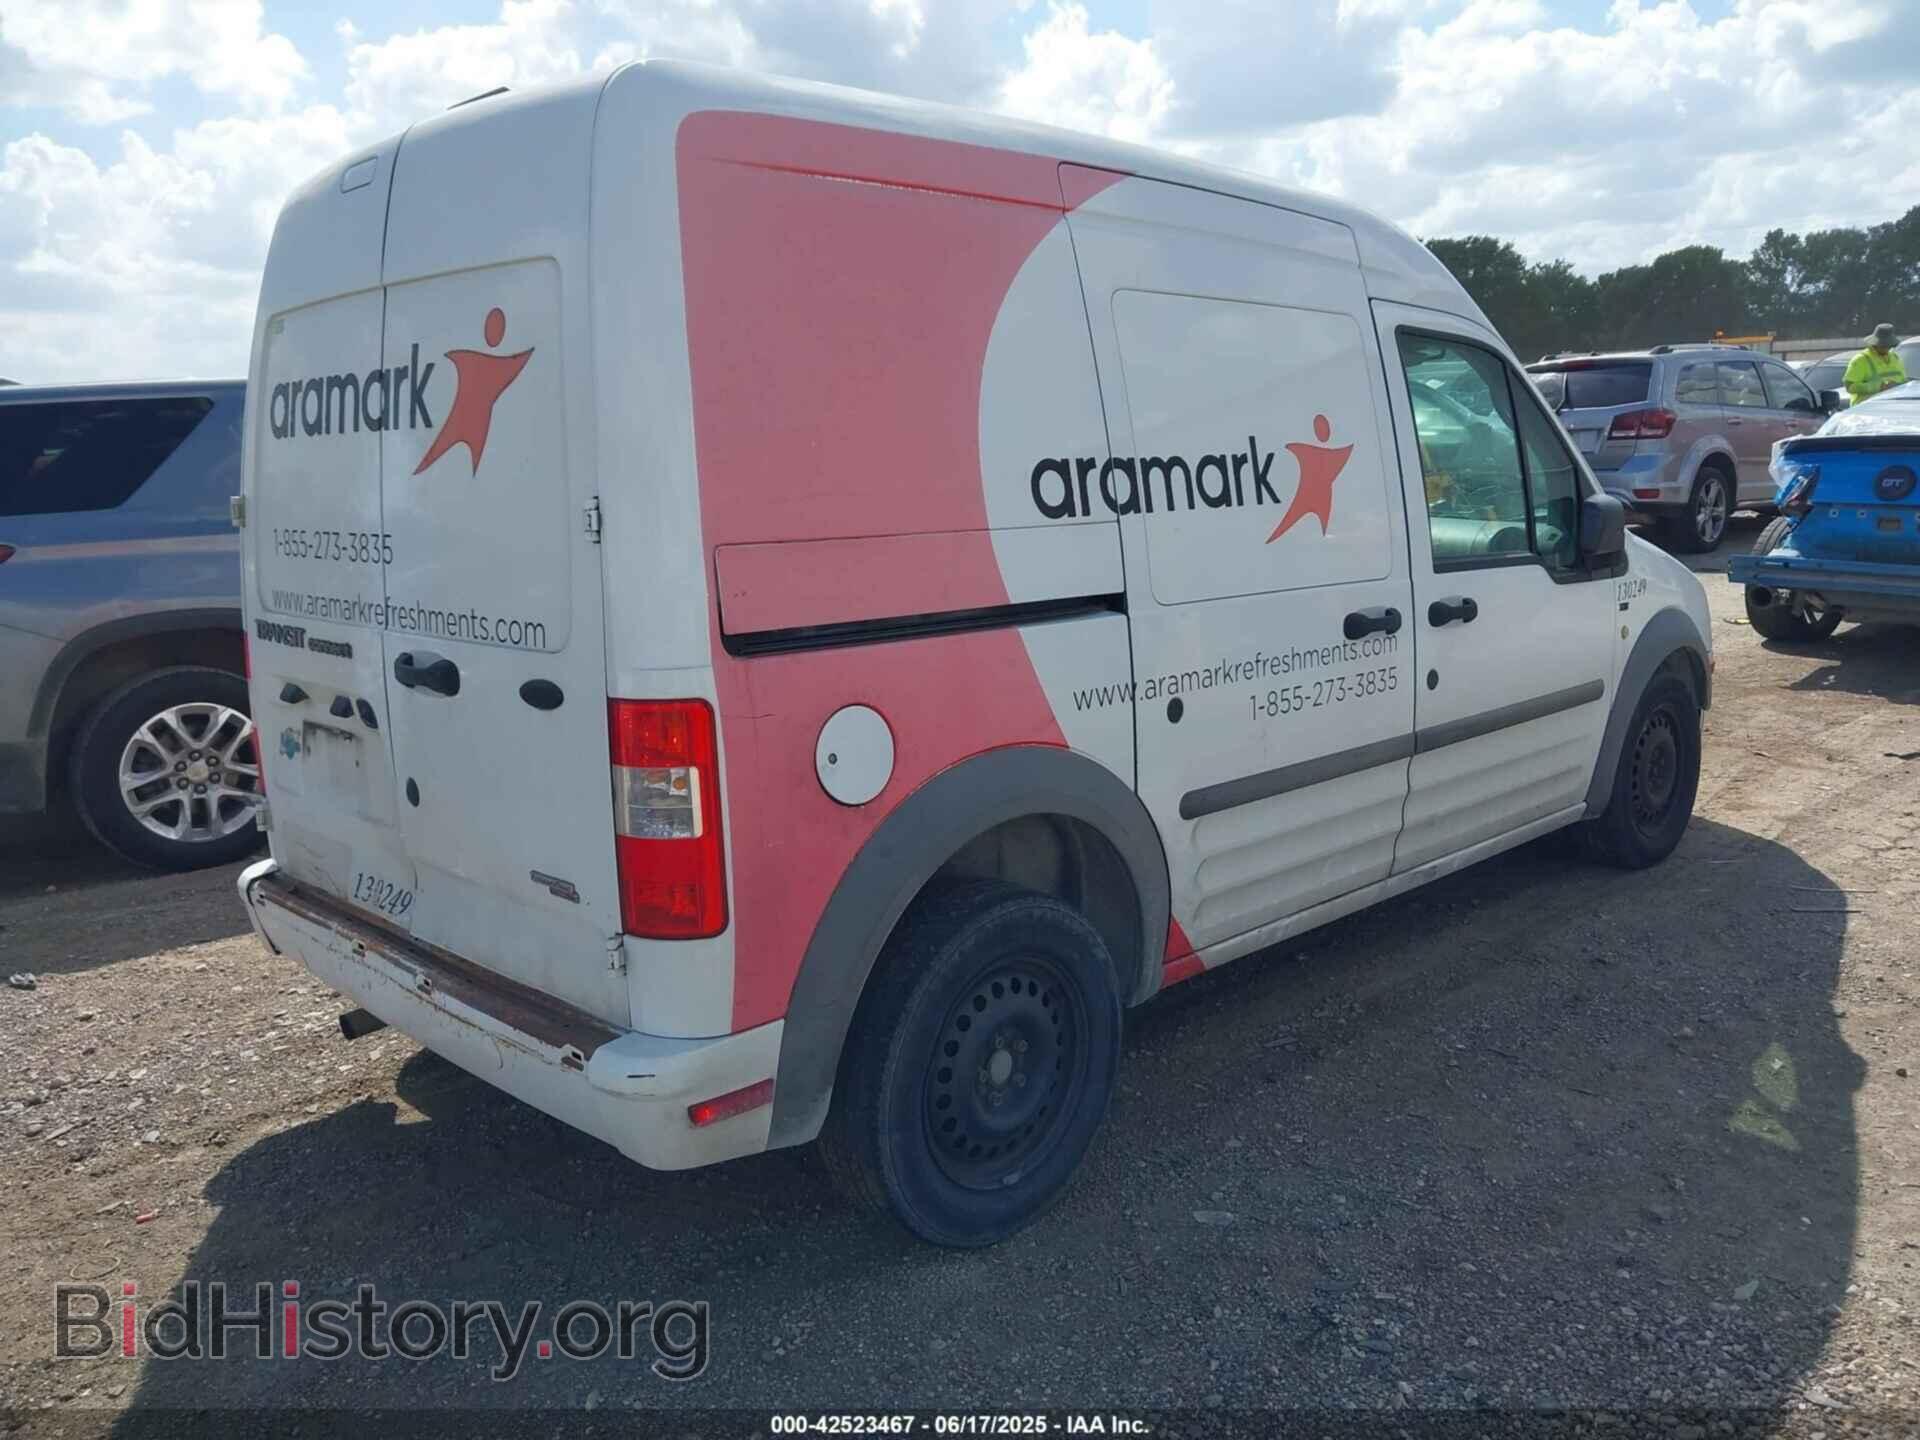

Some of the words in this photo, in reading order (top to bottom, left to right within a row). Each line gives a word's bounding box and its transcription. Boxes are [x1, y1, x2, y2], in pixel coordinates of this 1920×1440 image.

[269, 343, 435, 440] aramark
[1030, 435, 1282, 519] aramark
[273, 528, 394, 565] 1-855-273-3835
[271, 588, 547, 649] www.aramarkrefreshments.com
[1072, 633, 1399, 712] www.aramarkrefreshments.com
[1249, 665, 1399, 721] 1-855-273-3835
